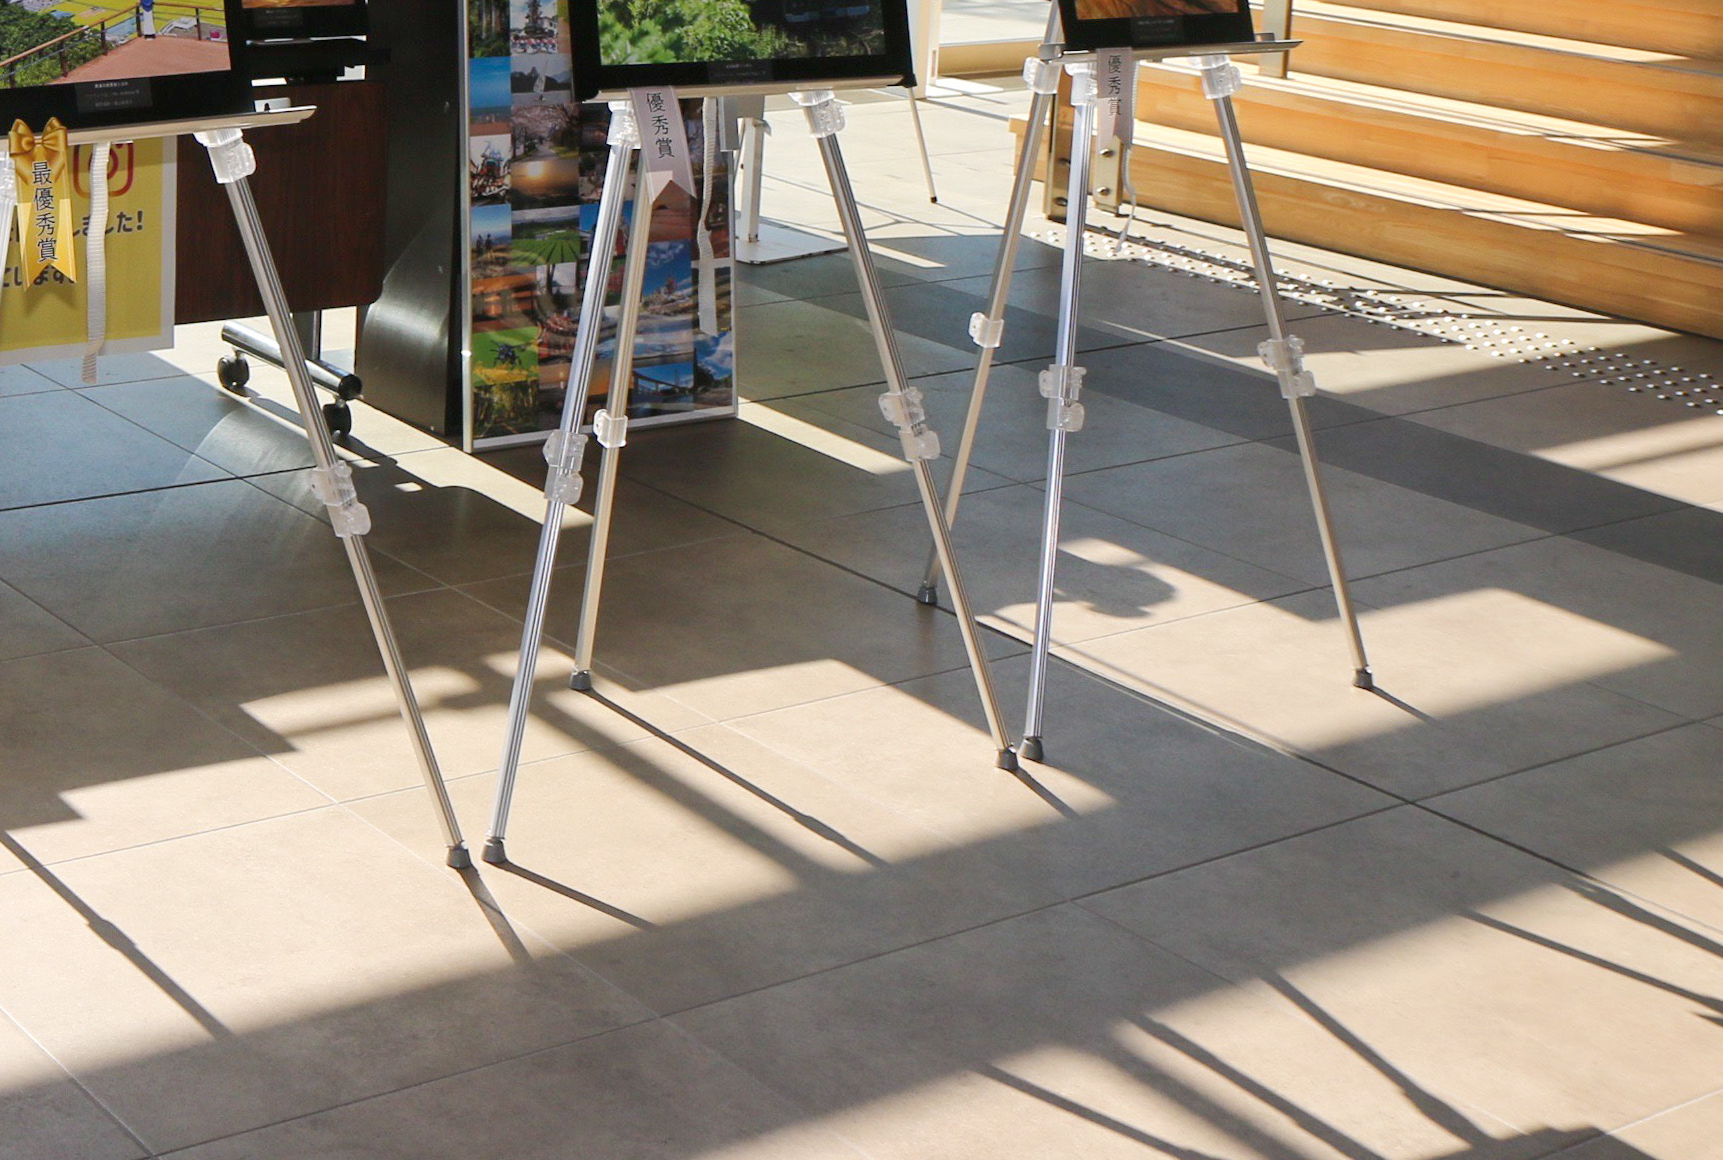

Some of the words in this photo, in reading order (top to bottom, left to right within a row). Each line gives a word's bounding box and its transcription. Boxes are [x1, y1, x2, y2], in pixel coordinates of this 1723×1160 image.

[646, 92, 676, 159] 優秀賞
[31, 160, 58, 263] 最優秀賞
